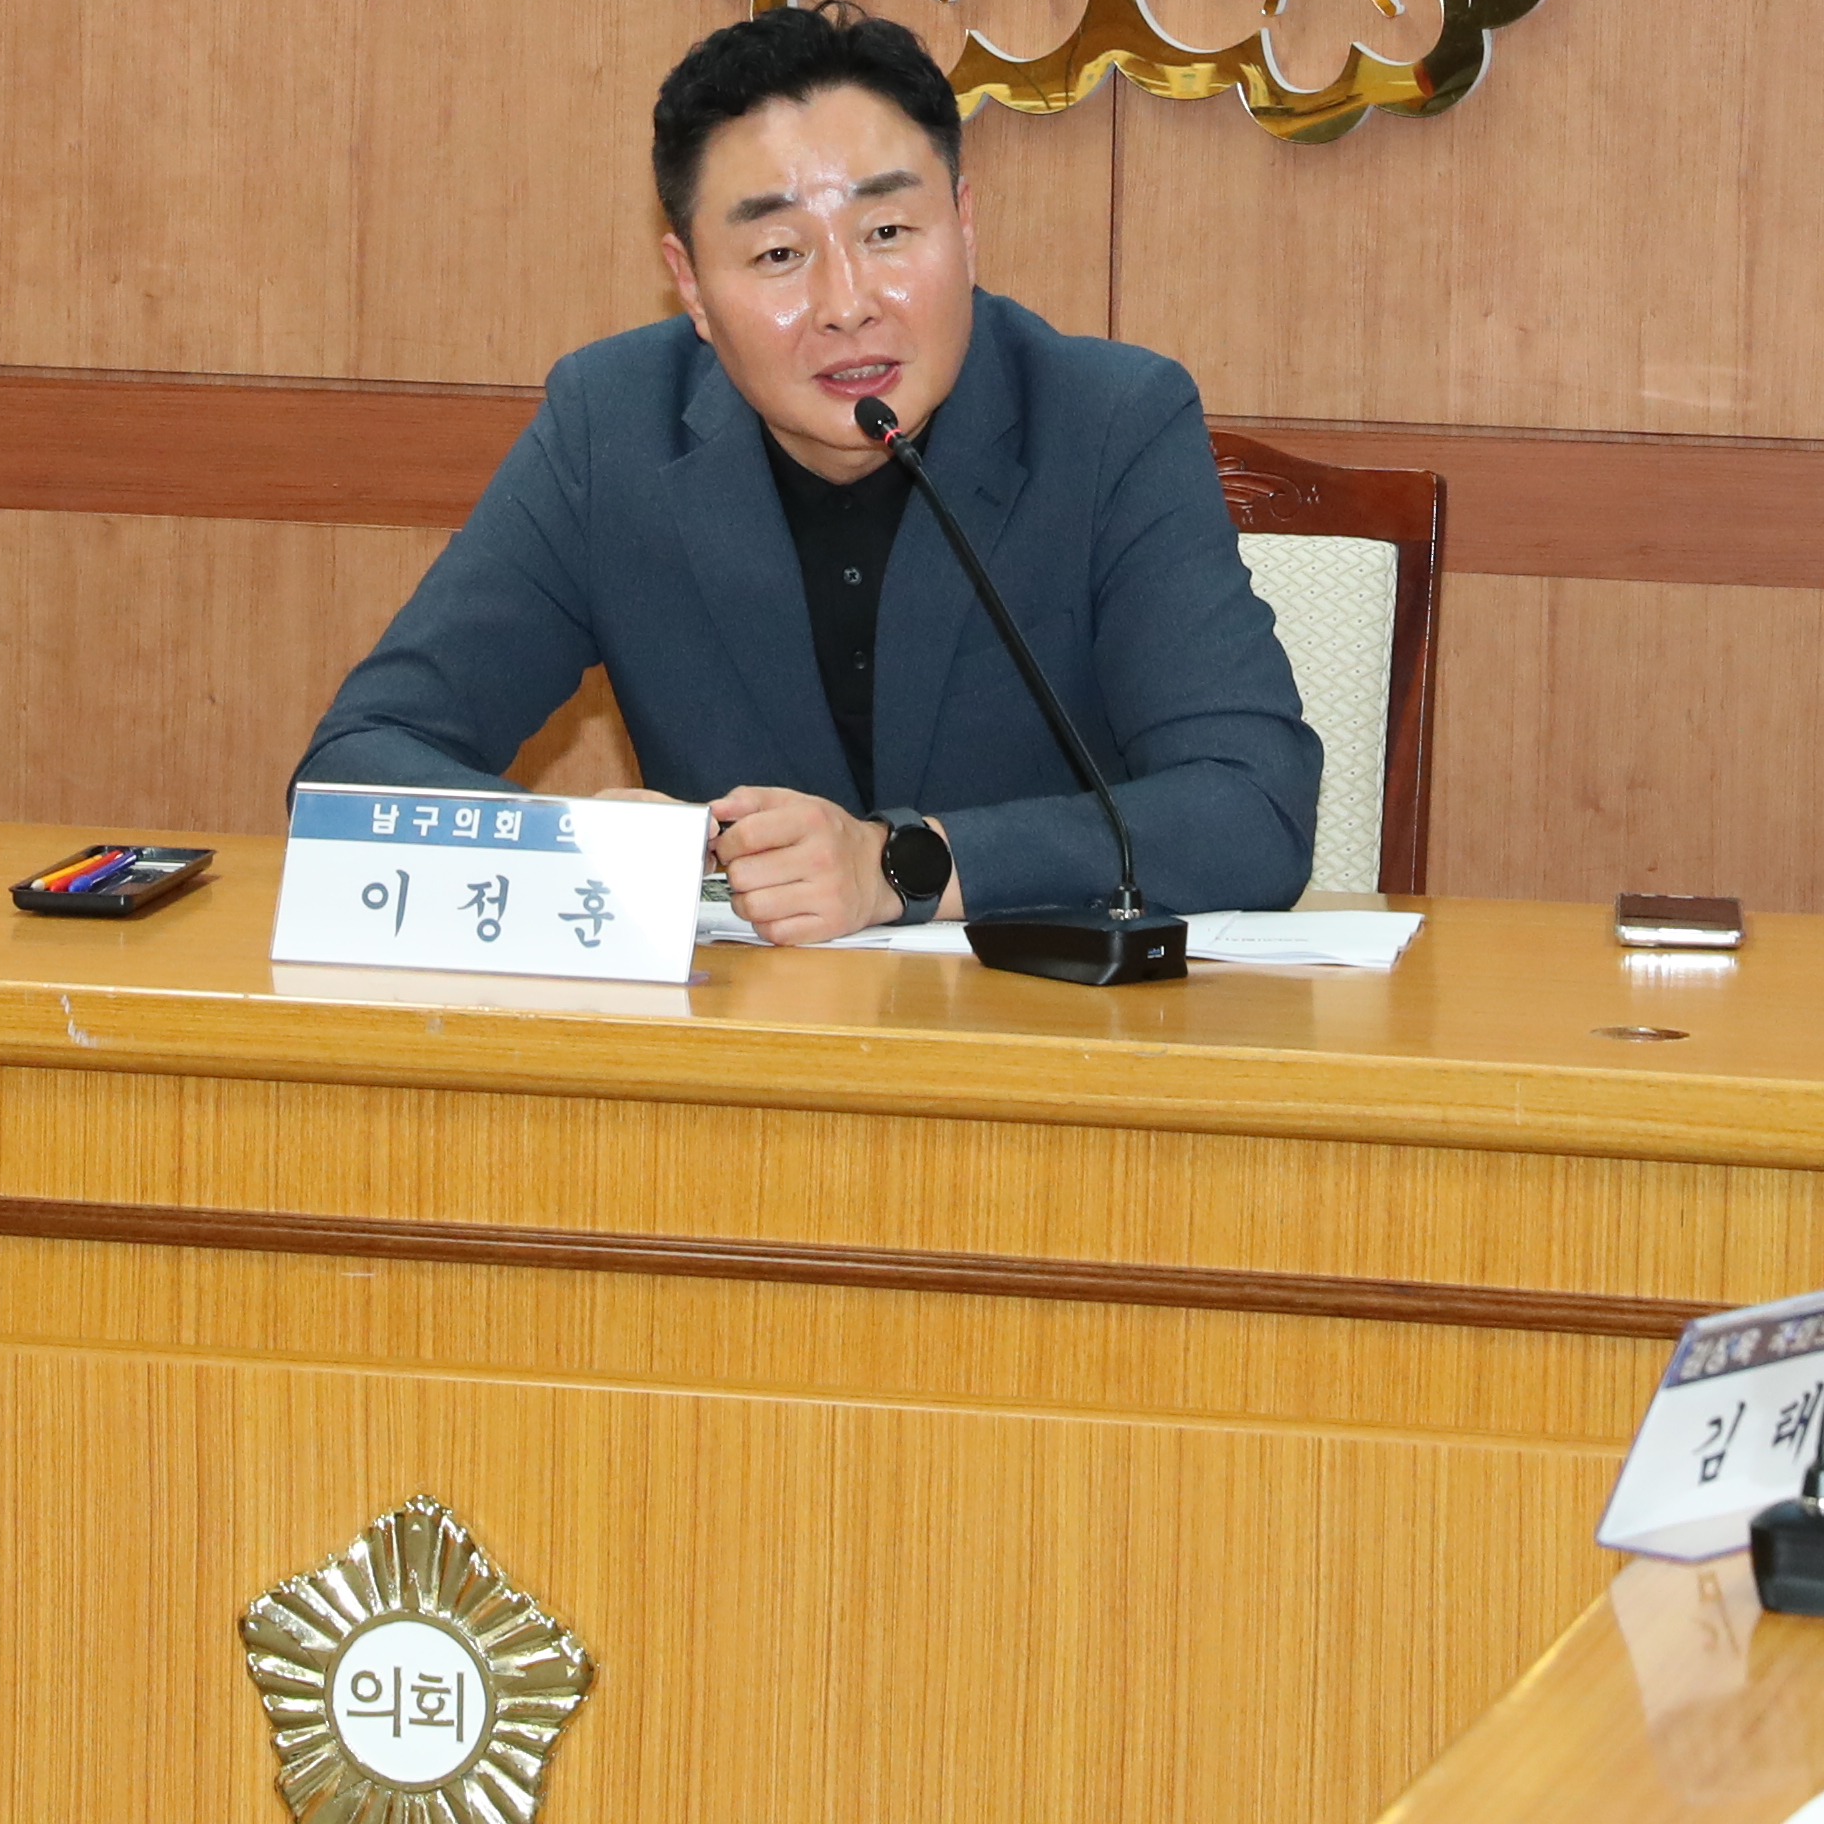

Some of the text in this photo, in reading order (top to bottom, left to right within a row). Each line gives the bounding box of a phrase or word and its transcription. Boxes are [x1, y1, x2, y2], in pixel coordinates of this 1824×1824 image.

[371, 803, 523, 842] 남구의회
[361, 869, 616, 949] 이정훈
[346, 1666, 465, 1743] 의회
